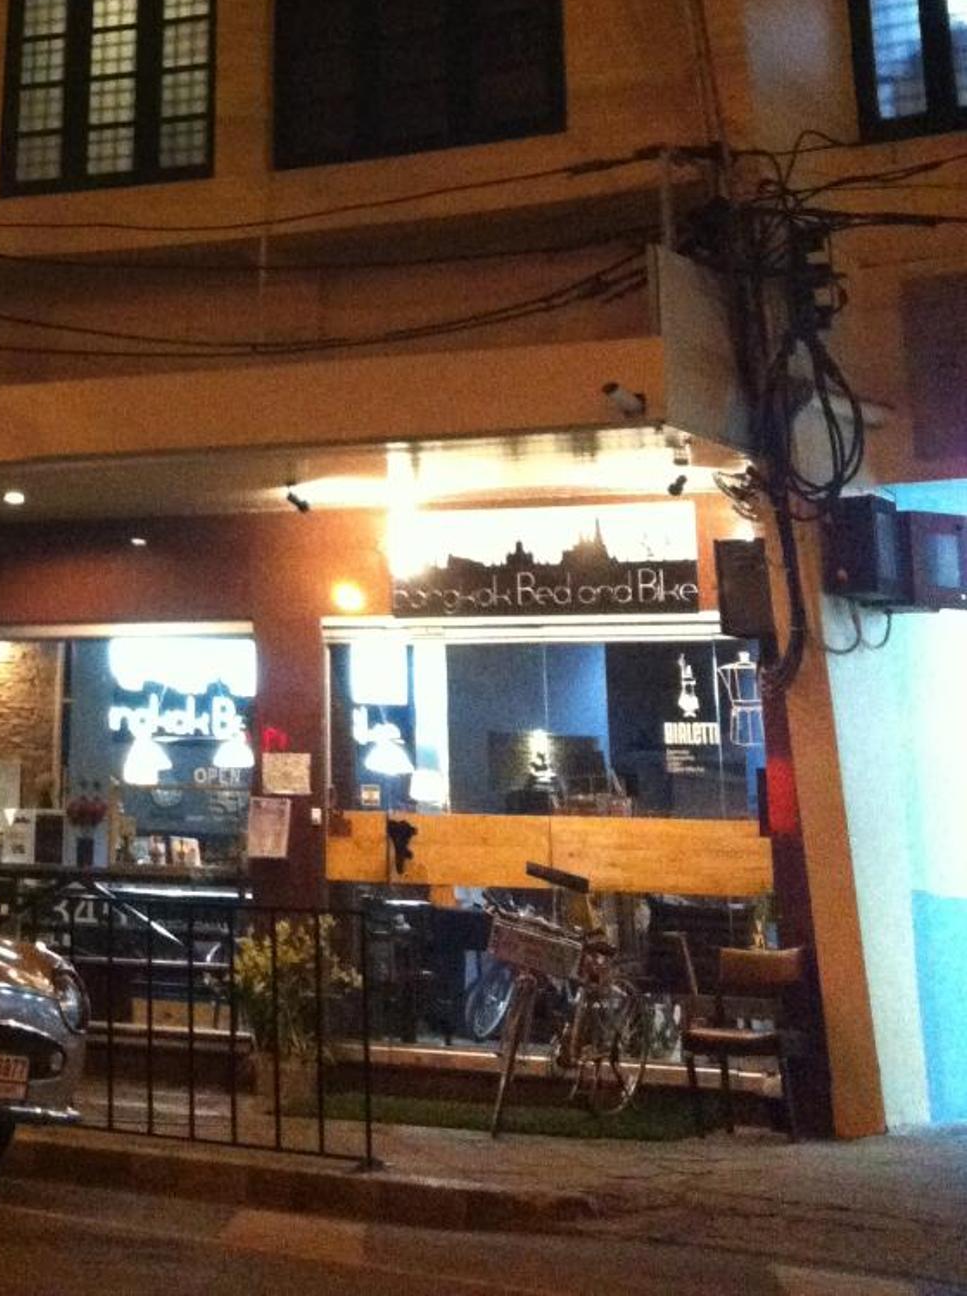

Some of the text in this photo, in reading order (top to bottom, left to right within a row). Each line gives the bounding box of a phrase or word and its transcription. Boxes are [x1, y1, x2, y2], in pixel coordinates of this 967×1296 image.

[577, 569, 633, 605] and
[636, 567, 699, 604] Bike
[193, 767, 242, 786] OPEN
